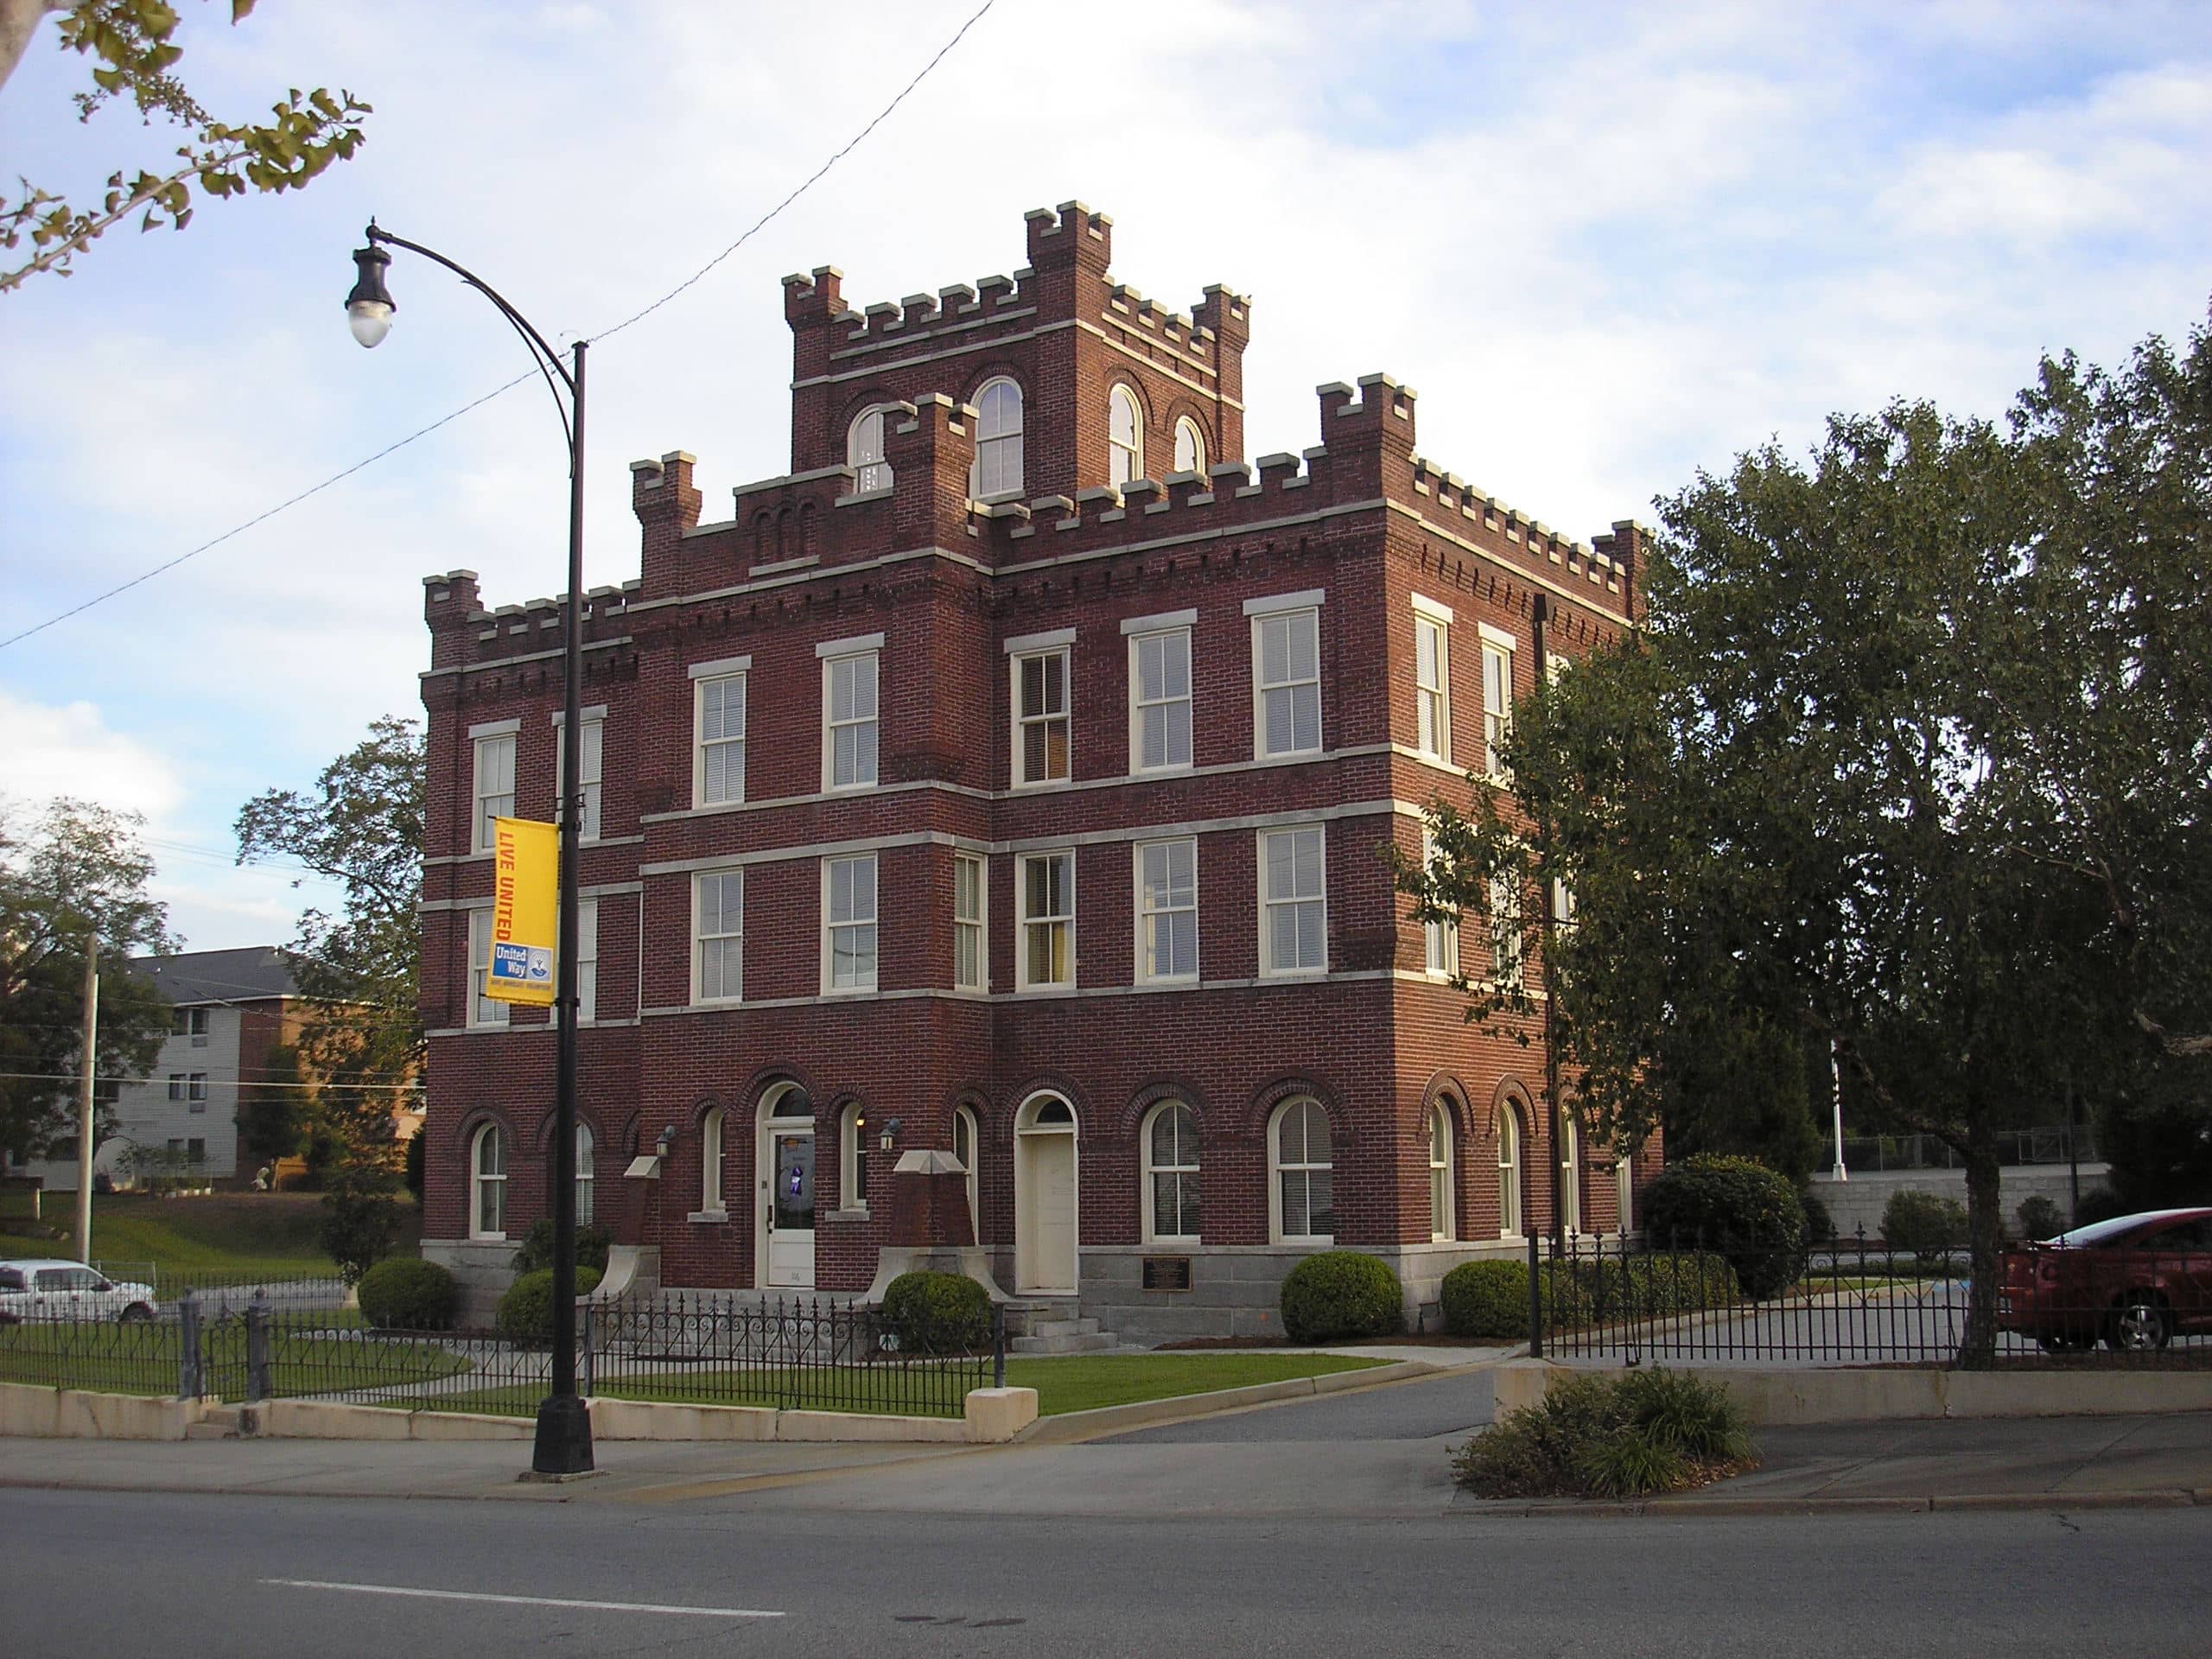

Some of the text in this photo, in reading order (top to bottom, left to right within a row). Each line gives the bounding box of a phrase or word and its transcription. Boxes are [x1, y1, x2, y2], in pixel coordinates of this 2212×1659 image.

[497, 832, 514, 941] LIVE UNITED
[496, 946, 526, 961] United
[507, 961, 526, 977] Way
